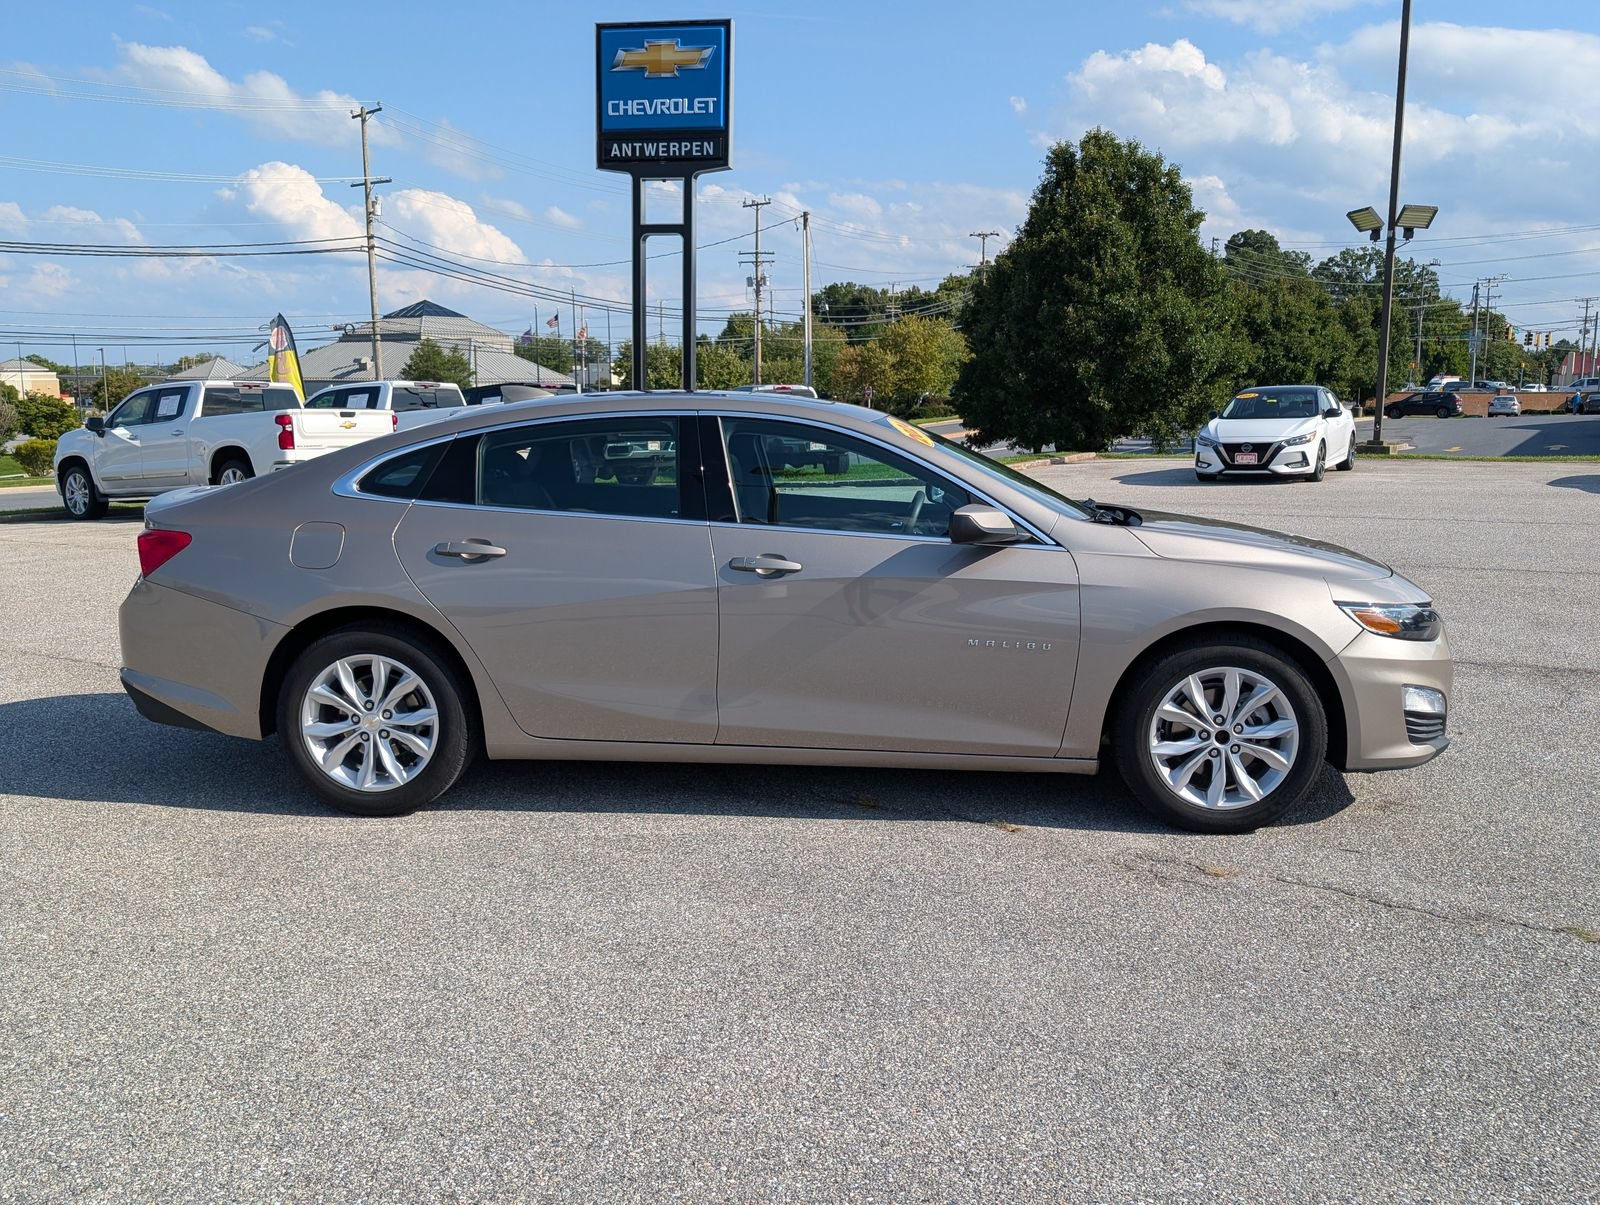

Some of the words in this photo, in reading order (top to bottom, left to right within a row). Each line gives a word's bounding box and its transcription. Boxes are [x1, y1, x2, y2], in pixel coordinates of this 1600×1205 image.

[608, 98, 717, 116] CHEVROLET
[610, 142, 714, 157] ANTWERPEN
[967, 639, 1052, 650] MALIBU
